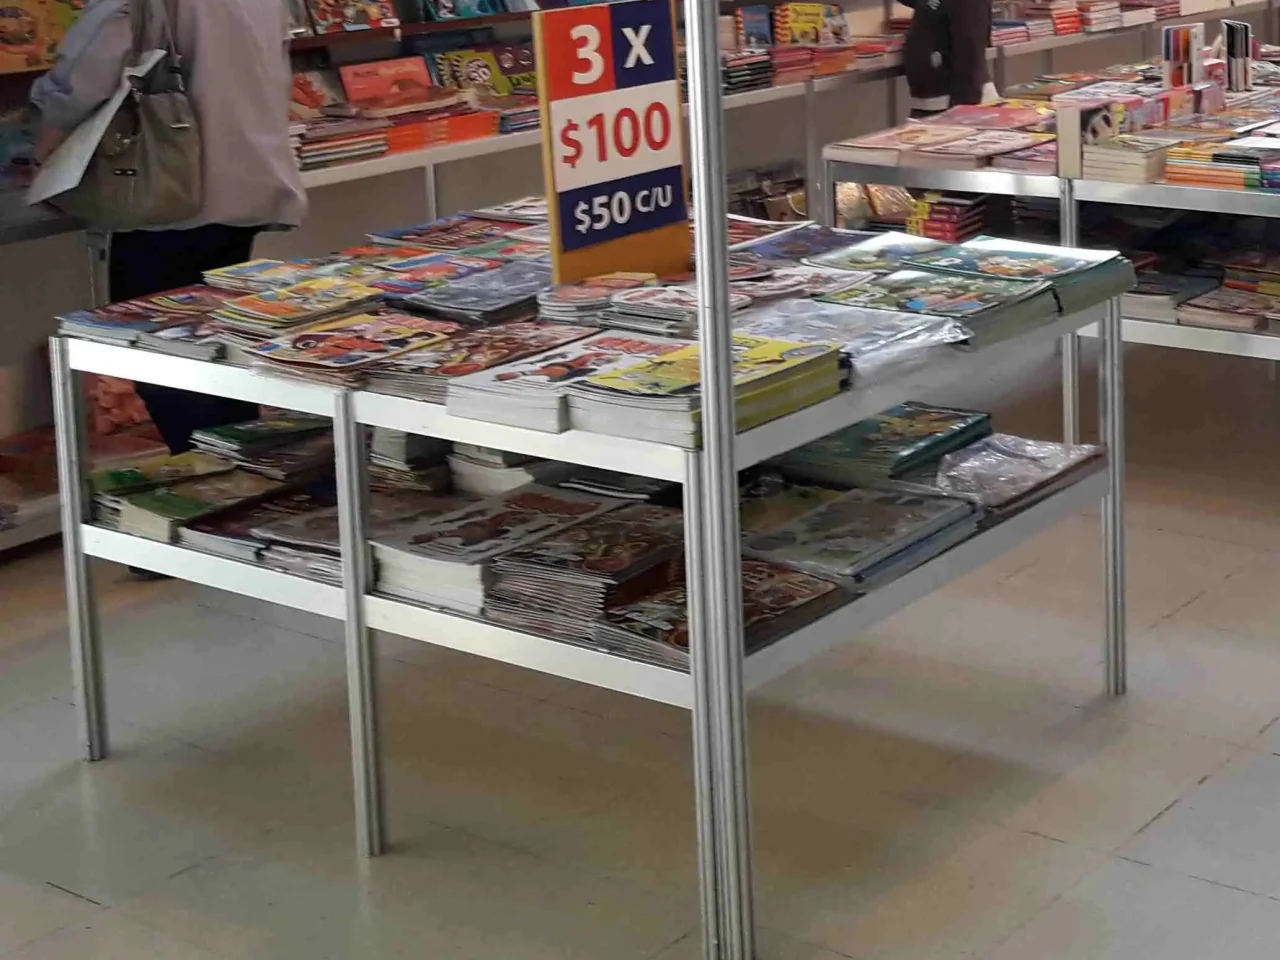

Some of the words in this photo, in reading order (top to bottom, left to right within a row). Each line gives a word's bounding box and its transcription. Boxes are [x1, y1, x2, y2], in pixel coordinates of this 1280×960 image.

[570, 23, 605, 85] 3
[560, 100, 672, 169] $100
[573, 190, 632, 234] $50
